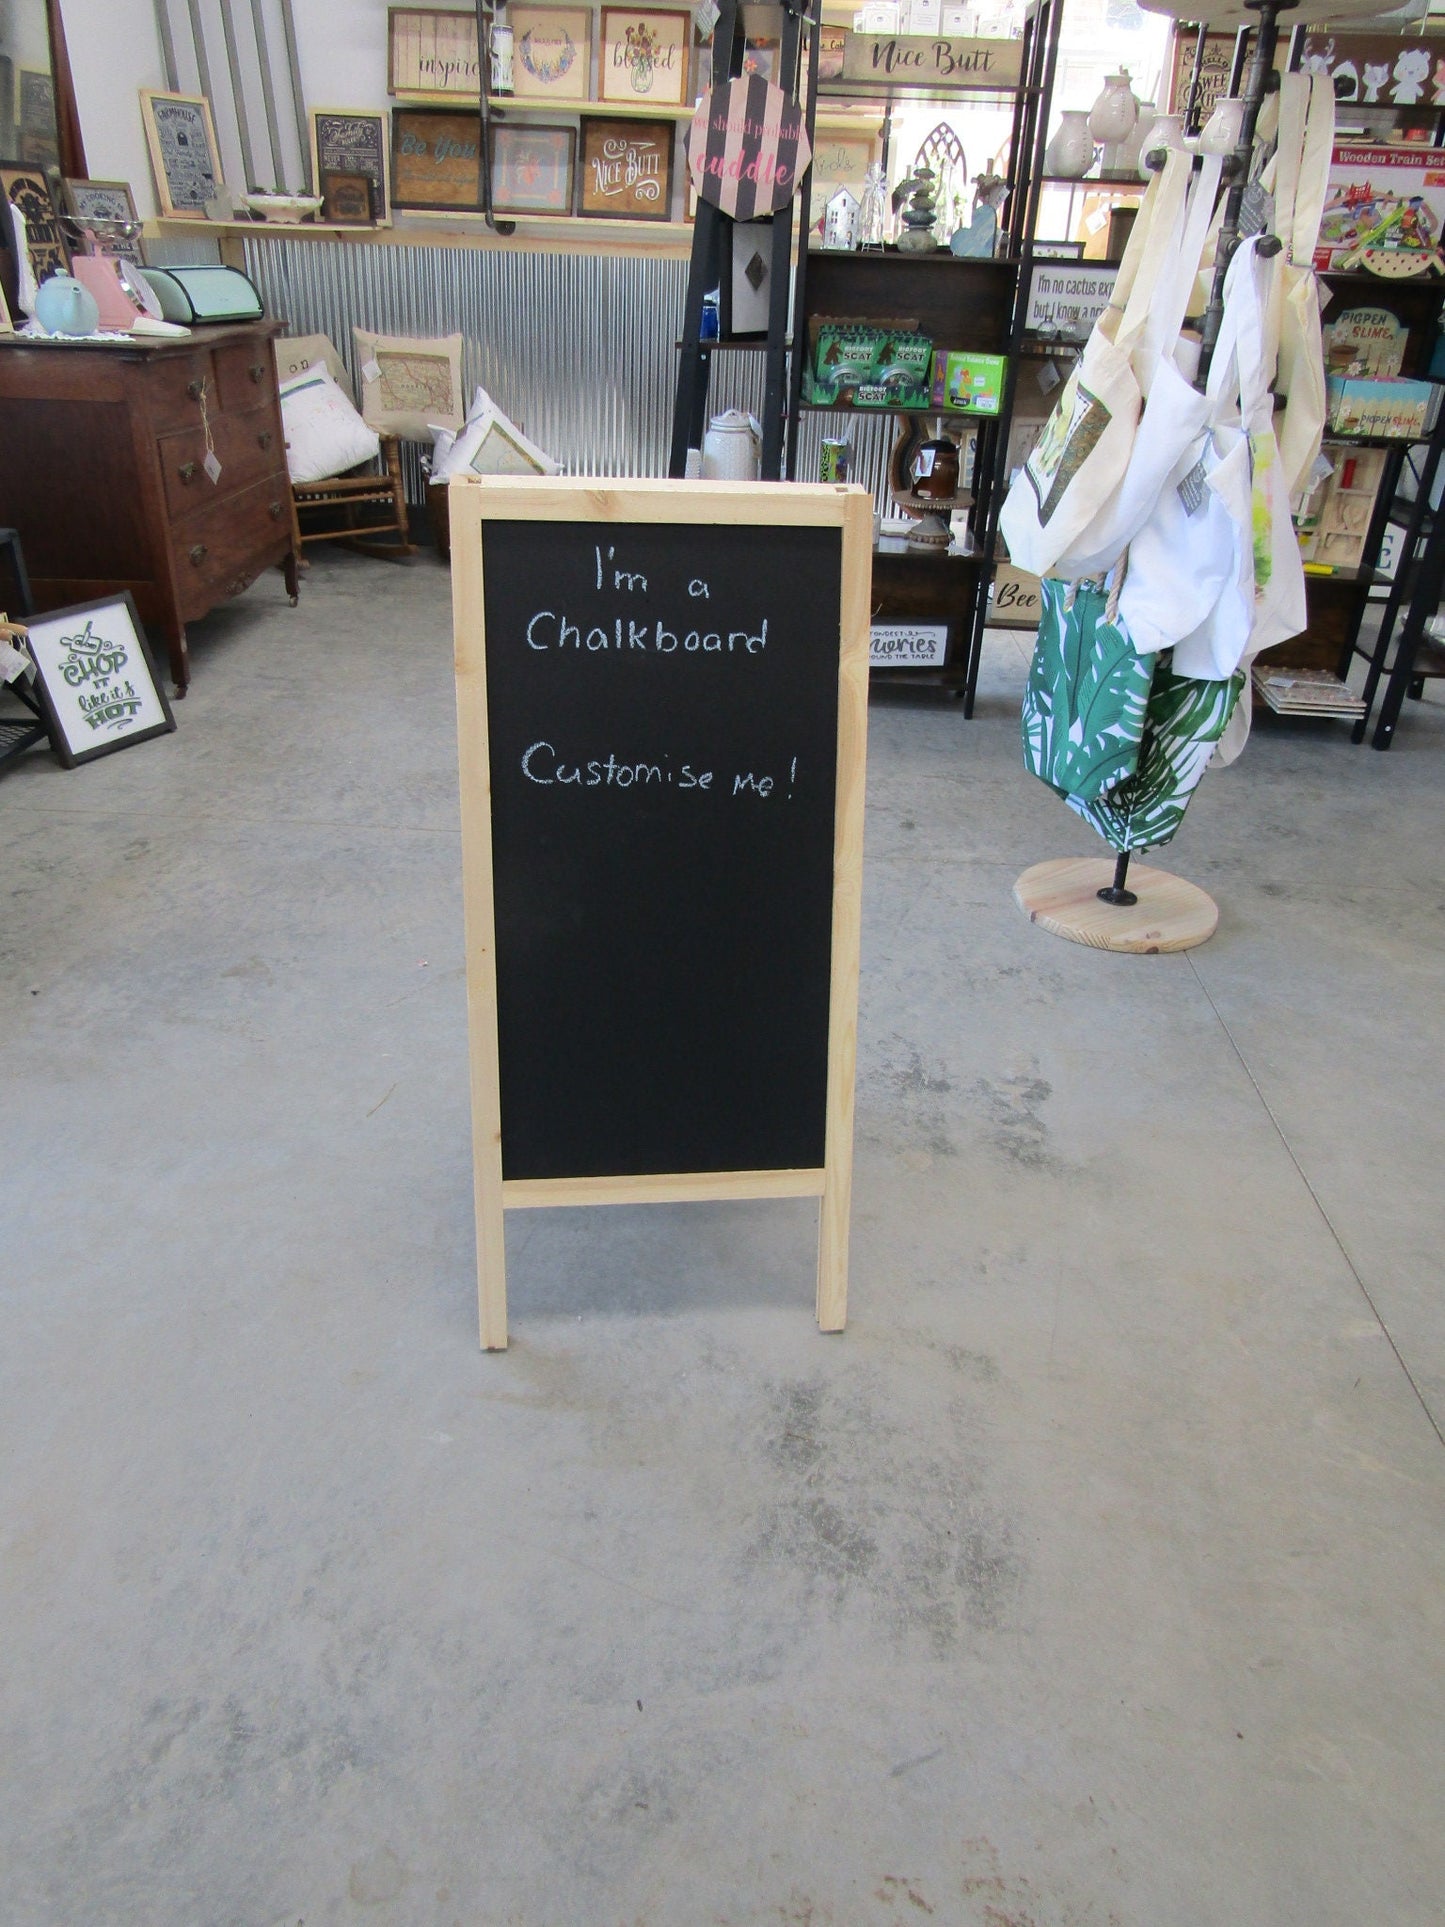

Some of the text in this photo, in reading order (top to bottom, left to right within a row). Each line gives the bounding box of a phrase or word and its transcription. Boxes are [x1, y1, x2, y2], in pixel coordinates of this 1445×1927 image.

[613, 41, 676, 73] blessed
[872, 40, 996, 75] Nice Butt
[713, 114, 751, 135] should
[401, 132, 476, 164] Be You
[1340, 151, 1386, 164] Wooden
[1390, 153, 1422, 165] Train
[696, 149, 795, 186] cuddle
[1037, 274, 1115, 299] I'm no cactus exp
[1034, 300, 1049, 318] but
[1051, 301, 1056, 317] I
[1056, 302, 1079, 320] know
[1081, 307, 1088, 318] a
[1341, 312, 1387, 325] PIGPEN
[843, 352, 872, 361] SCAT
[897, 353, 925, 362] SCAT
[858, 392, 886, 401] SCAT
[1362, 414, 1392, 425] PIGPEN
[595, 546, 710, 599] I'm a
[996, 583, 1038, 608] Bee
[526, 611, 768, 653] Chalkboard
[62, 651, 129, 686] CHOP
[93, 677, 110, 689] IT
[79, 693, 109, 712] like
[85, 701, 142, 730] HOT
[520, 741, 713, 790] Customise
